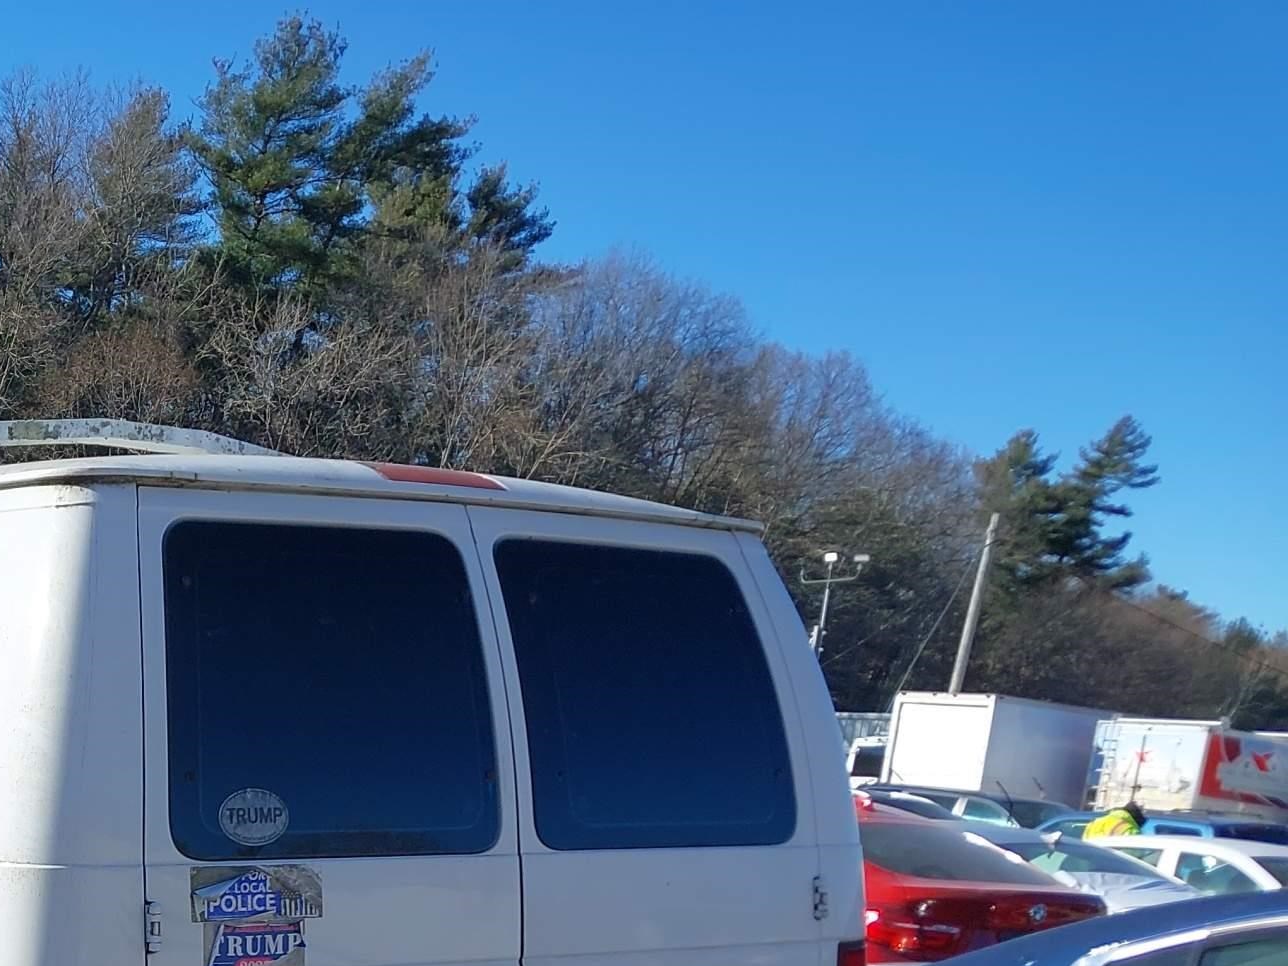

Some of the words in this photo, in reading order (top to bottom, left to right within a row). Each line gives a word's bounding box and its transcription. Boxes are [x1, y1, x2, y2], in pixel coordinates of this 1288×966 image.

[225, 807, 283, 824] TRUMP
[234, 882, 273, 893] LOCAL
[209, 893, 278, 913] POLICE
[215, 932, 302, 957] TRUMP
